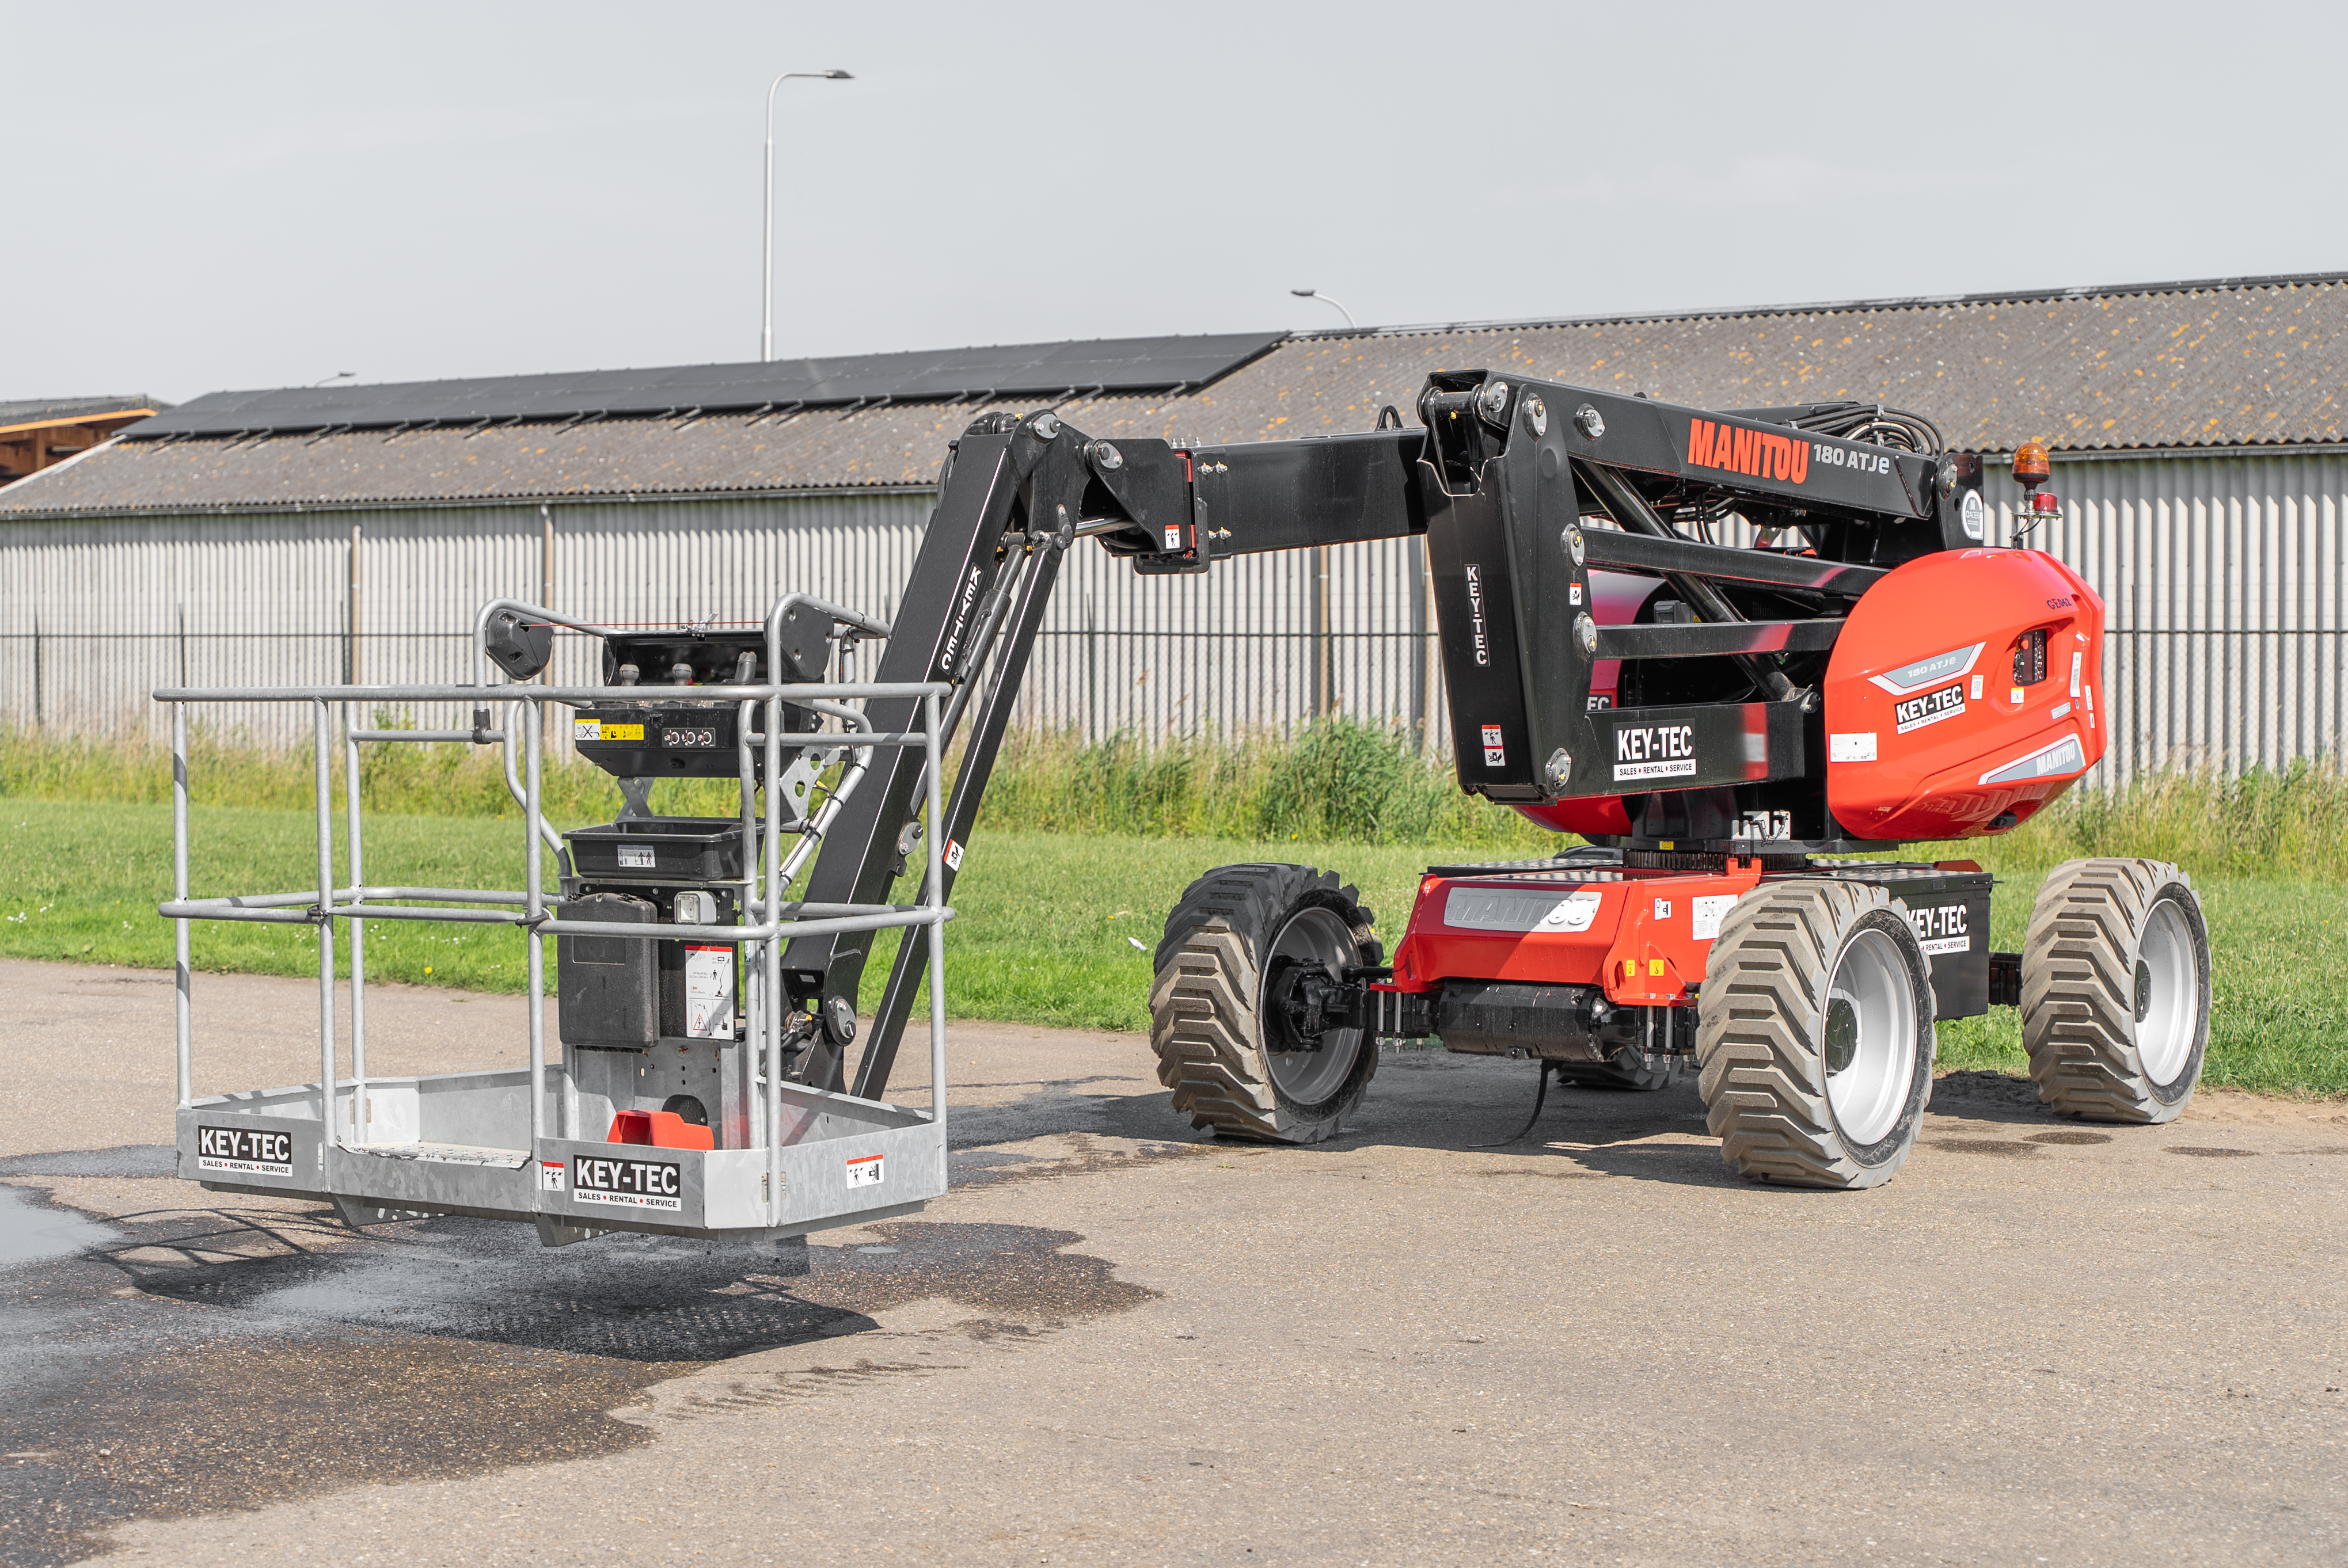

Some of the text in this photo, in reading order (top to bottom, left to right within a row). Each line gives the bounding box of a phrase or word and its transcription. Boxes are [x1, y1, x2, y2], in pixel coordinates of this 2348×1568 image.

[1688, 418, 1810, 484] MANITOU
[1814, 444, 1845, 466] 180
[941, 566, 982, 670] KEY-TEC
[1466, 566, 1487, 665] KEY-TEC
[1907, 665, 1928, 678] 180
[1896, 686, 1963, 724] KEY-TEC
[1901, 706, 1963, 731] SALES RENTAL SERVICE
[1618, 725, 1693, 761] KEY-TEC
[2036, 741, 2076, 776] MANITOU
[1620, 763, 1692, 776] SALES RENTAL SERVICE
[1446, 895, 1597, 925] MANITOU
[1926, 943, 1943, 952] RENTAL
[1948, 940, 1966, 949] SERVICE
[200, 1129, 290, 1161] KEY-TEC
[230, 1162, 254, 1170] RENTAL
[261, 1164, 289, 1174] SERVICE
[576, 1159, 678, 1194] KEY-TEC
[578, 1192, 678, 1208] SALES RENTAL SERVICE
